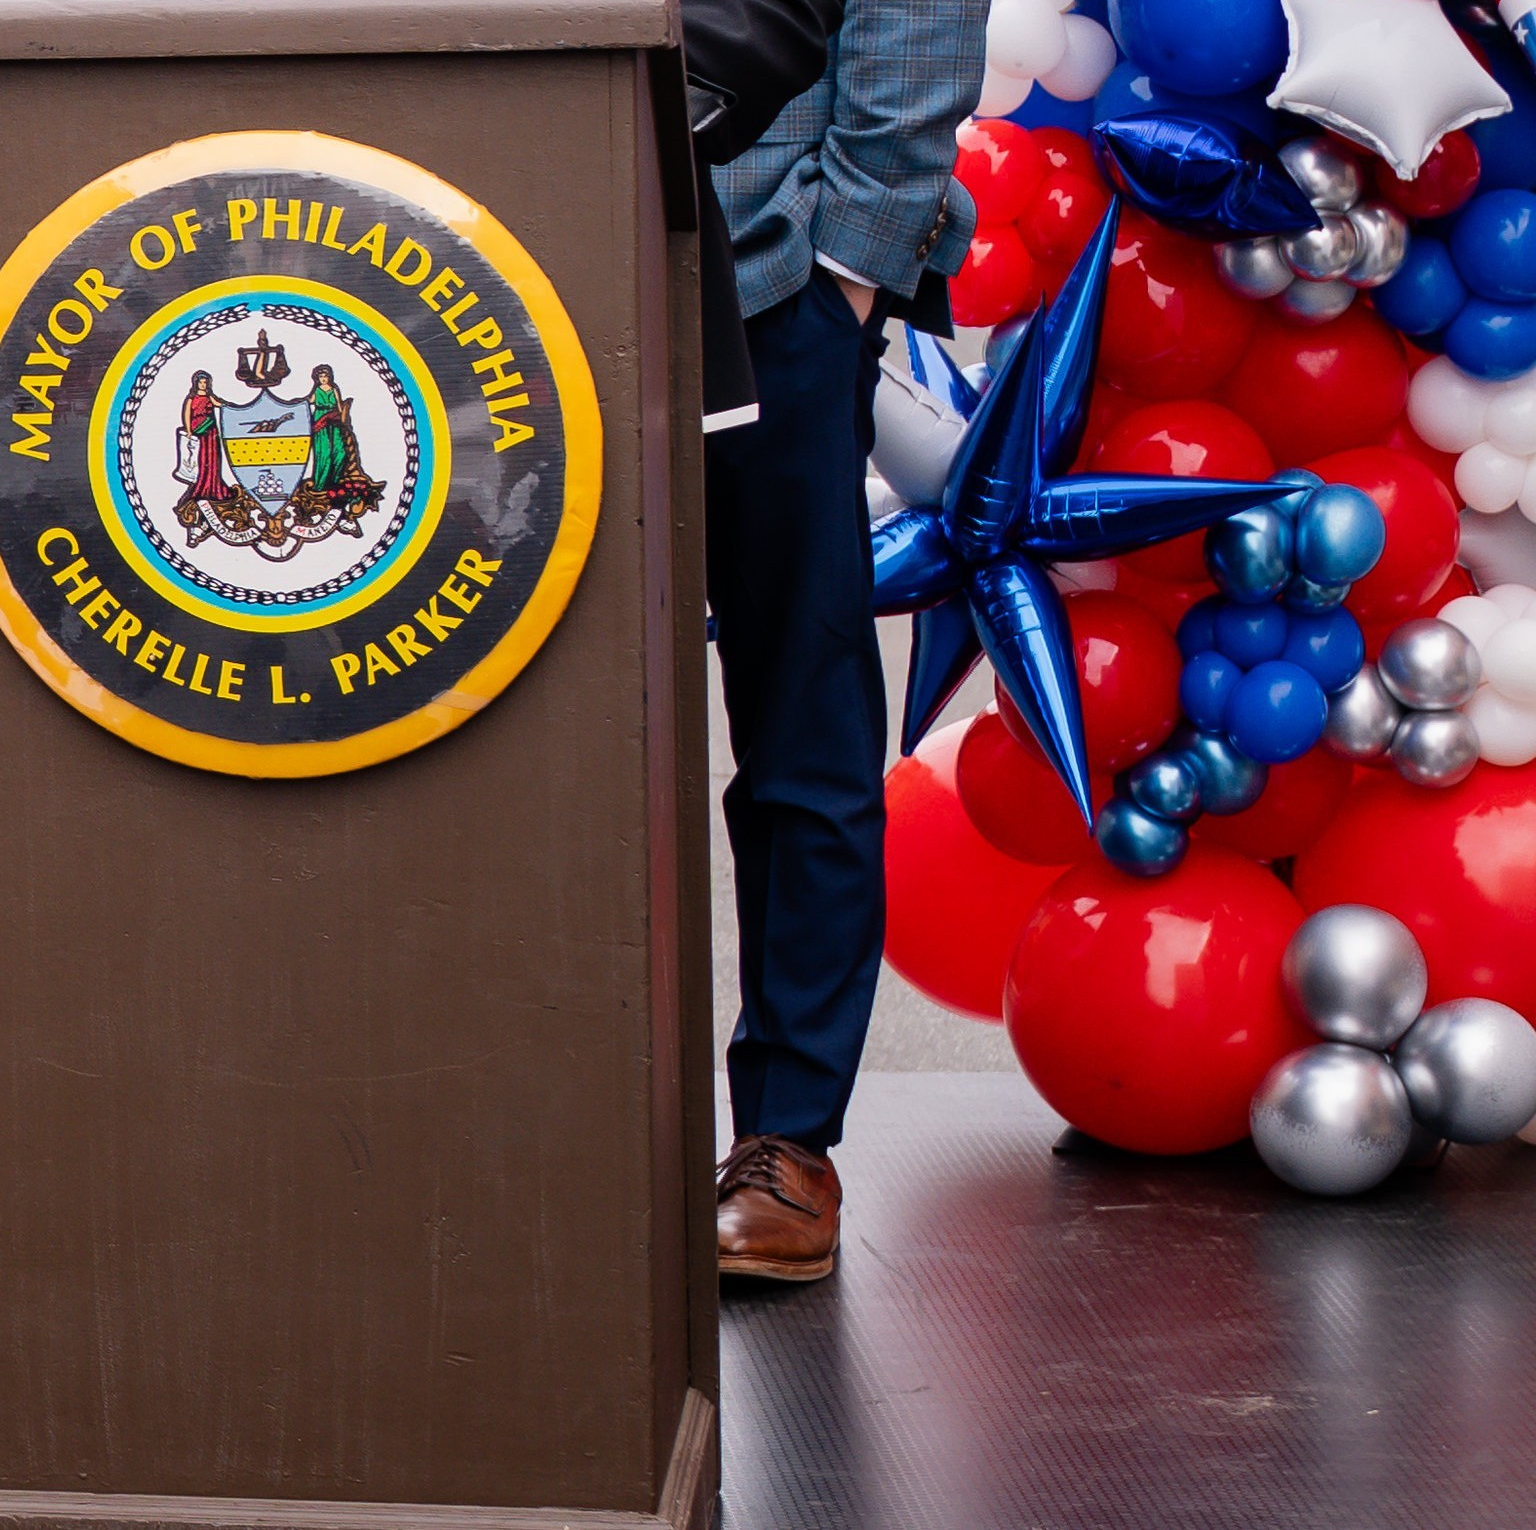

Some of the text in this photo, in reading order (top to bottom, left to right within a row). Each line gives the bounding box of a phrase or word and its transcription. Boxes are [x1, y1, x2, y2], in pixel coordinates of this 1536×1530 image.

[9, 198, 535, 462] MAYOR OF PHILADELPHIA
[37, 527, 502, 704] CHERELLE L. PARKER
